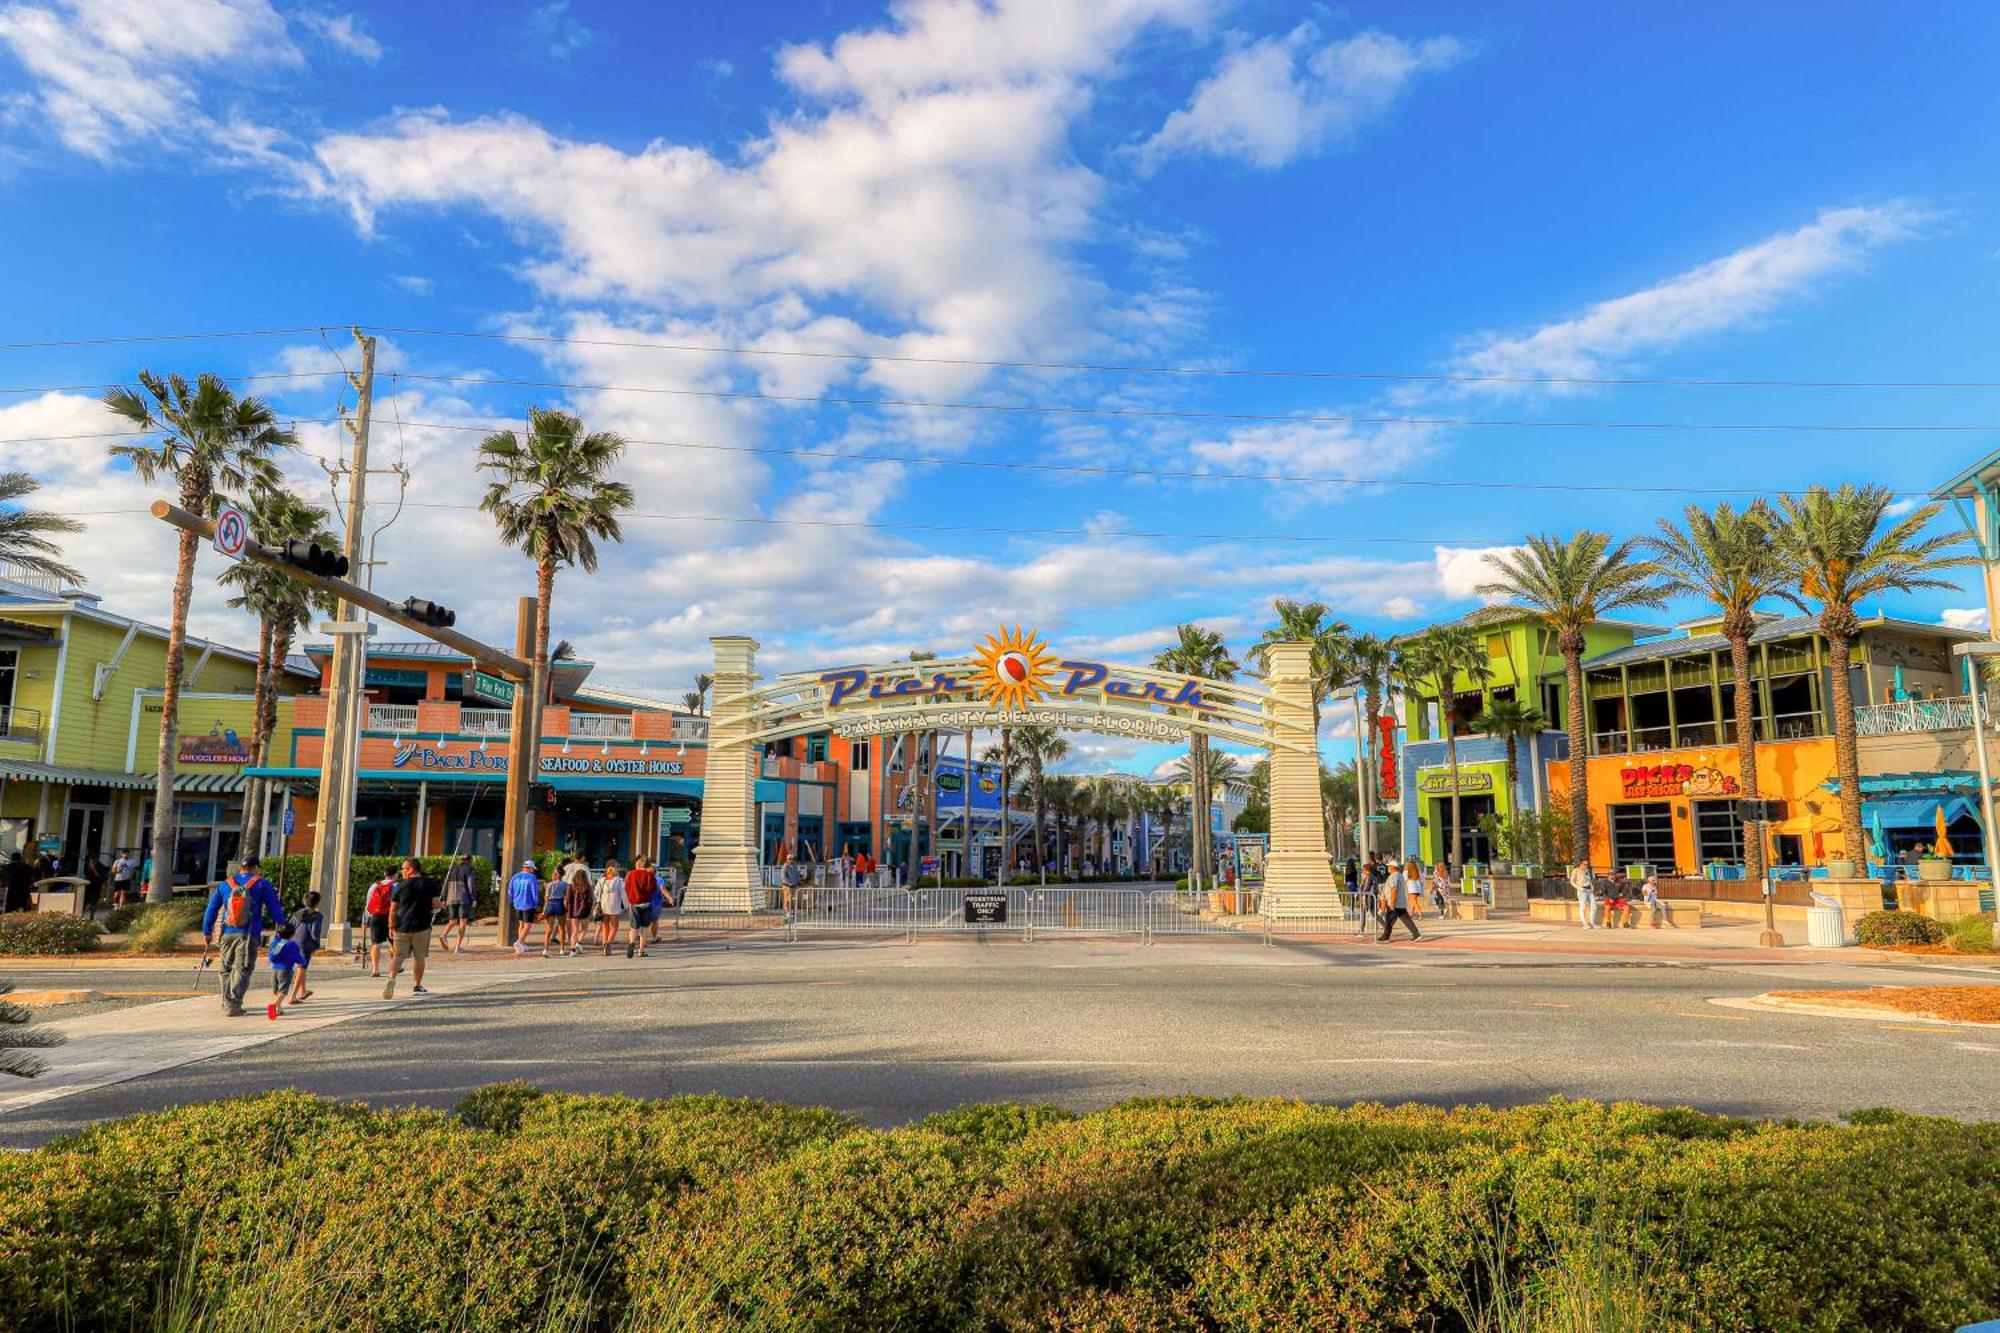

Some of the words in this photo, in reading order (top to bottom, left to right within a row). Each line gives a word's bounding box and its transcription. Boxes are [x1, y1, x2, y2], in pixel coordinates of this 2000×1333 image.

[482, 679, 493, 693] Pier
[820, 669, 974, 708] Pier
[1059, 661, 1218, 711] Park
[840, 714, 929, 739] PANAMA
[938, 711, 988, 725] CITY
[998, 710, 1068, 726] BEACH
[1093, 715, 1185, 739] FLORIDA
[468, 749, 510, 770] PORC
[540, 757, 590, 772] SEAFOOD
[592, 758, 603, 772] &
[606, 759, 646, 773] OYSTER
[648, 760, 684, 774] HOUSE
[1620, 764, 1694, 786] DICK'S
